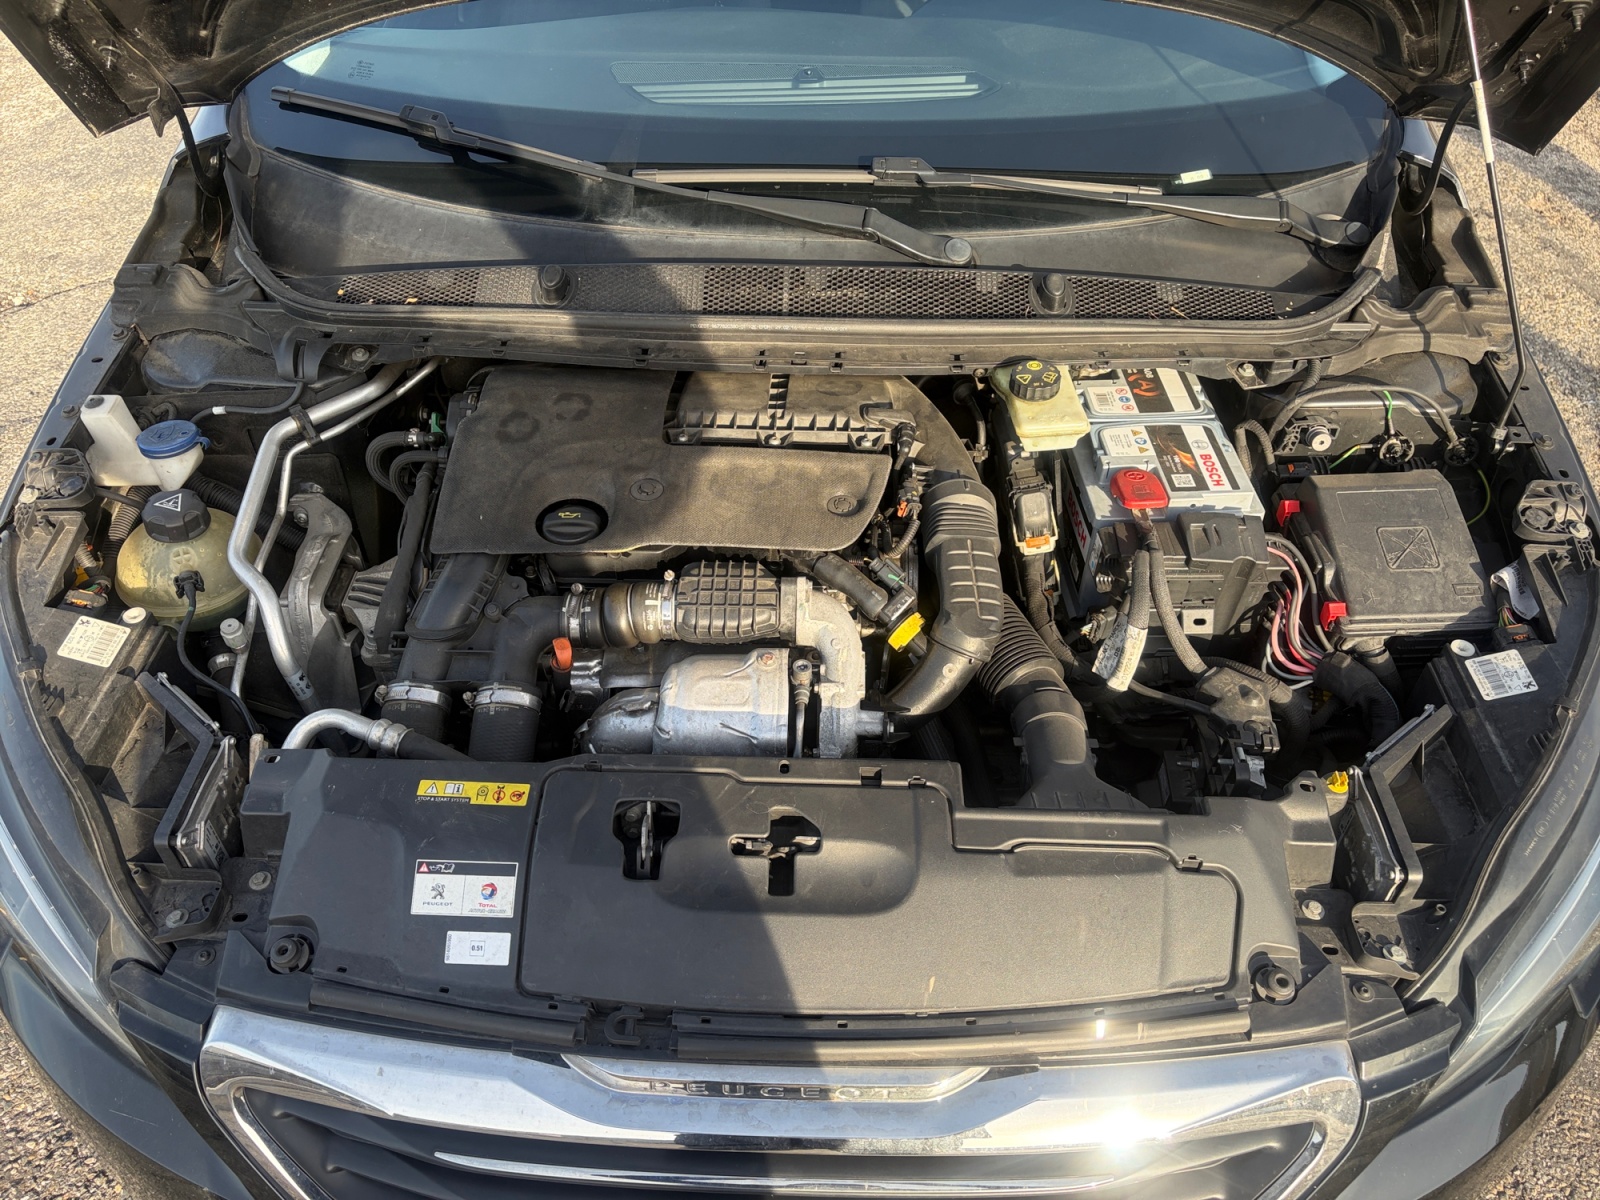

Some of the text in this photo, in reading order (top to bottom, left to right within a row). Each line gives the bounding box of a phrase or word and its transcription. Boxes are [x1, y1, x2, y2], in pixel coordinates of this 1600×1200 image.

[1200, 454, 1225, 487] BOSCH
[1068, 490, 1087, 549] BOSCH
[649, 1080, 899, 1099] PEUGEOT
